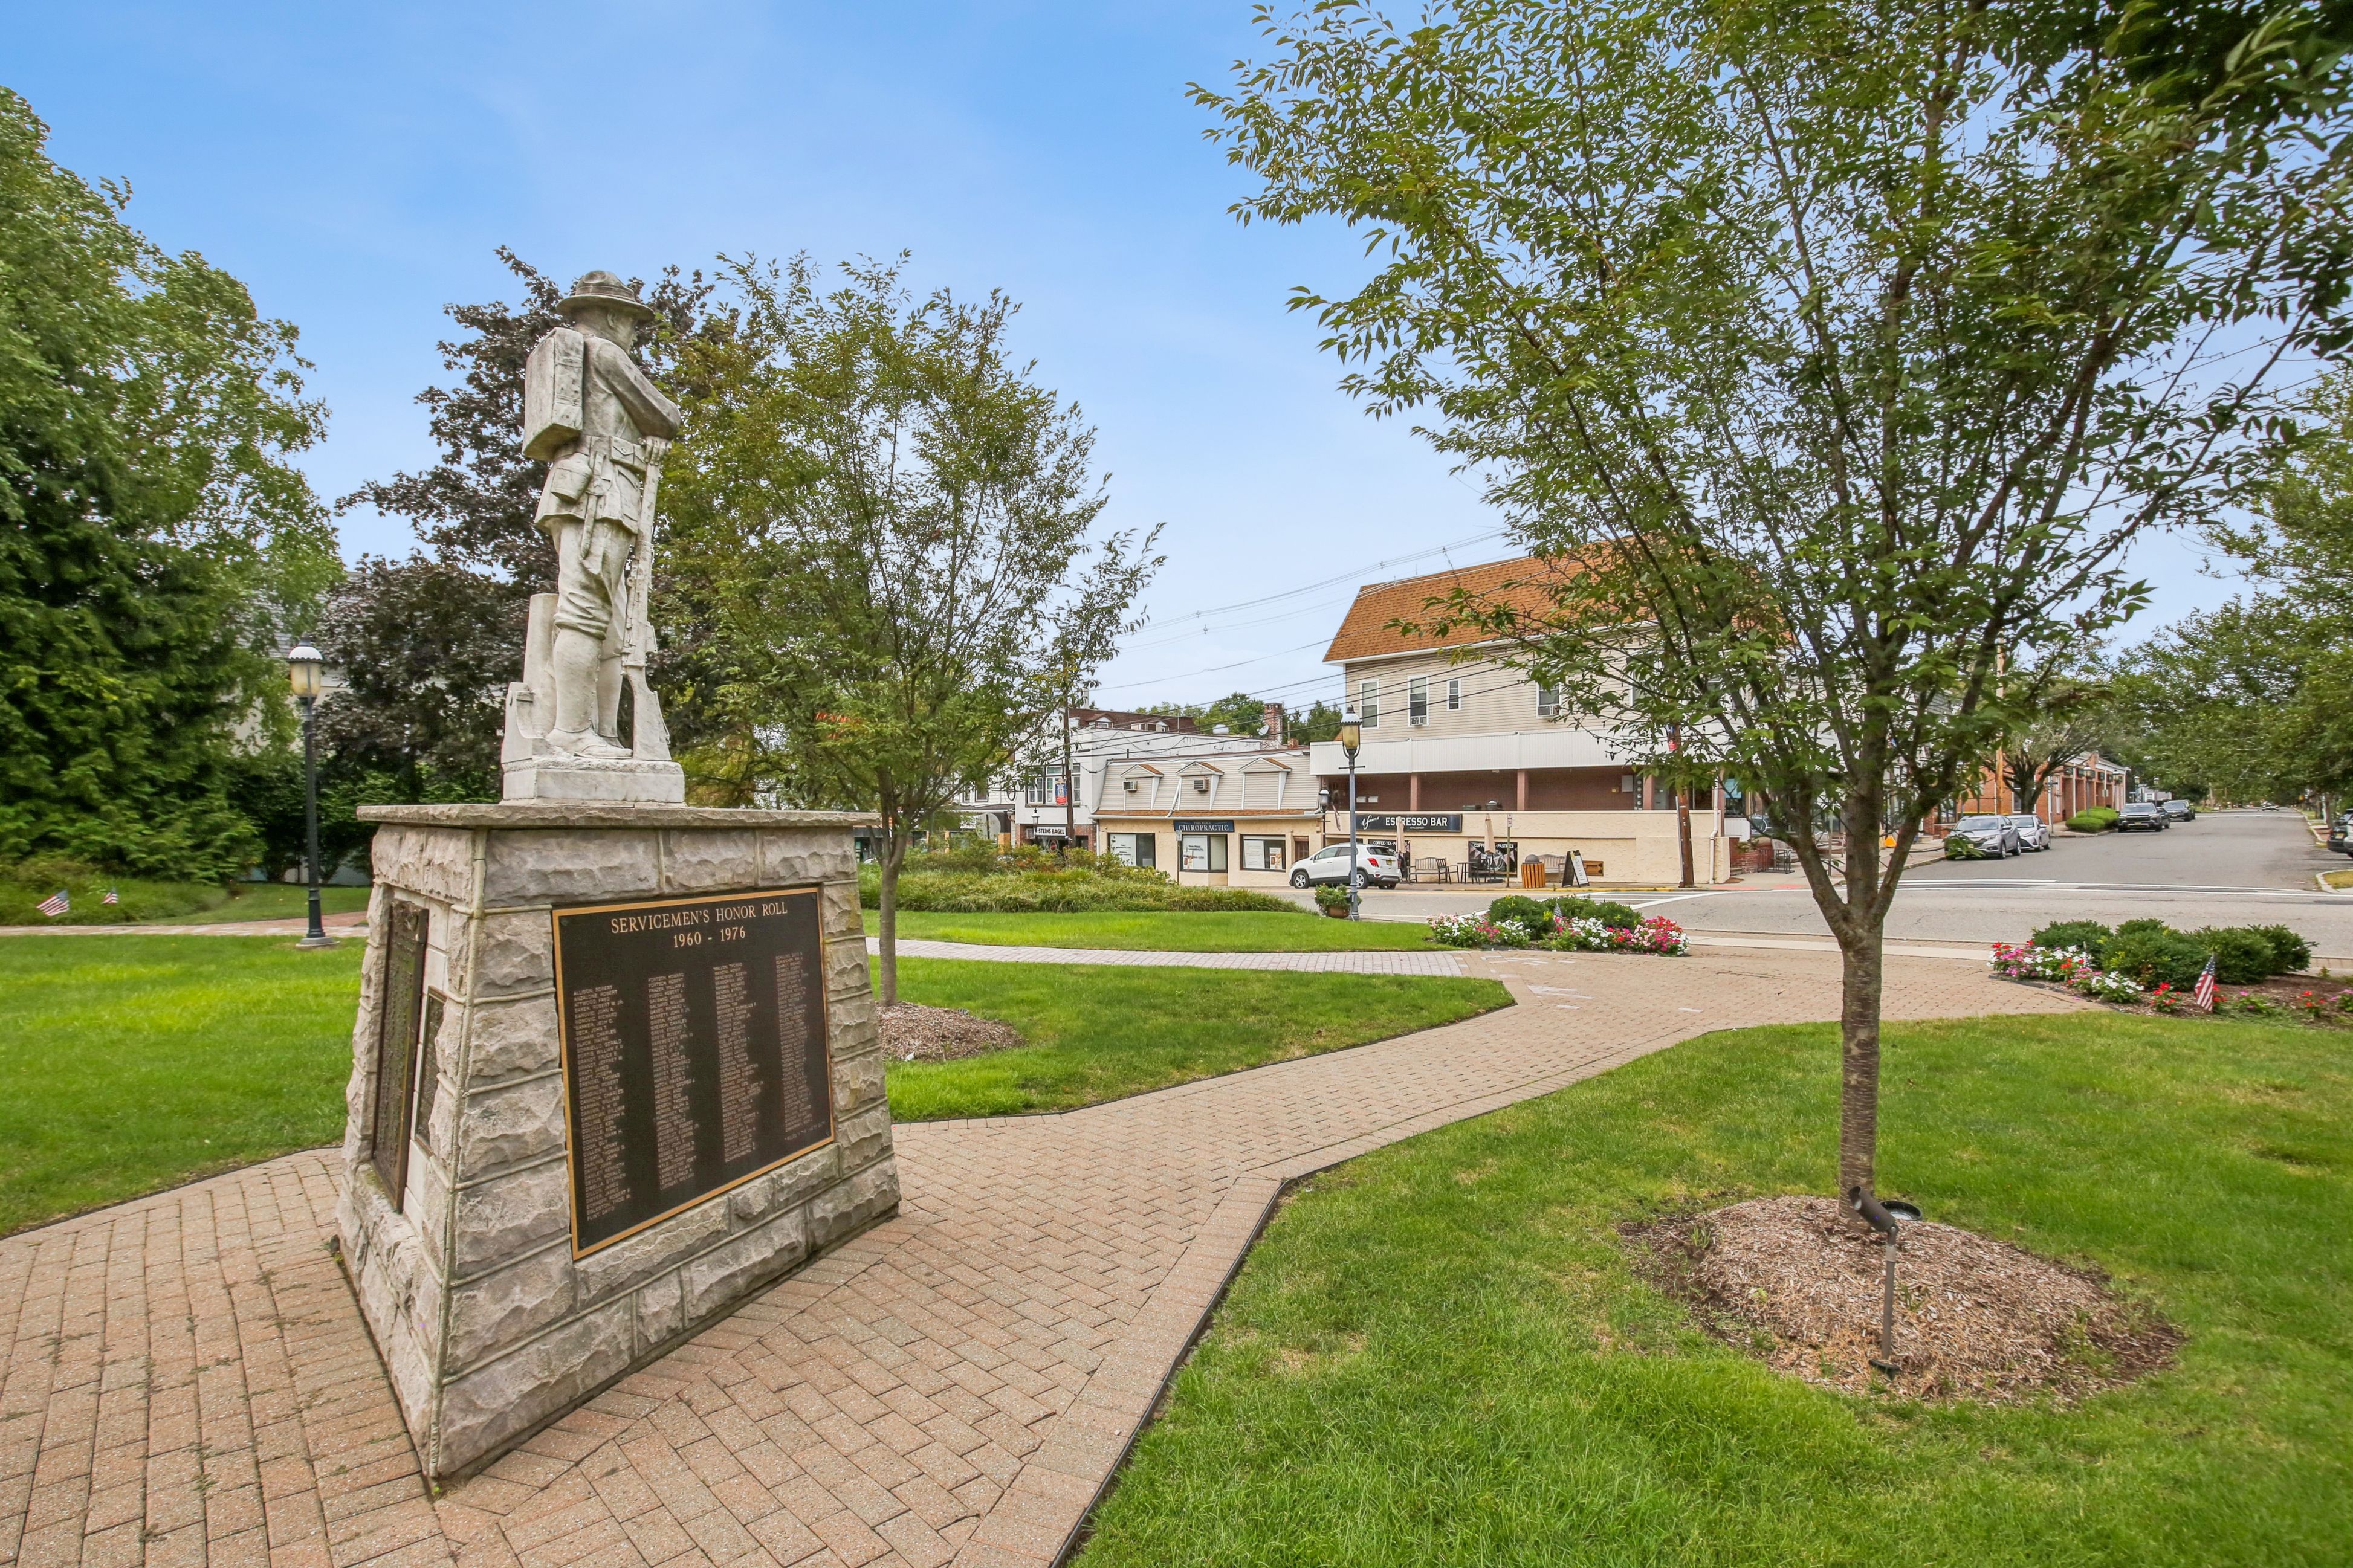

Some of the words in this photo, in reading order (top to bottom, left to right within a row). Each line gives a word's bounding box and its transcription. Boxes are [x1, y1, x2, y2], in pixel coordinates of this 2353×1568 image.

[1385, 816, 1428, 827] ESRESSO
[1430, 817, 1448, 827] BAR
[611, 909, 710, 934] SERVICEMEN'S
[716, 905, 756, 922] HONOR
[762, 902, 788, 916] ROLL
[673, 931, 701, 948] 1960
[720, 926, 745, 941] 1976
